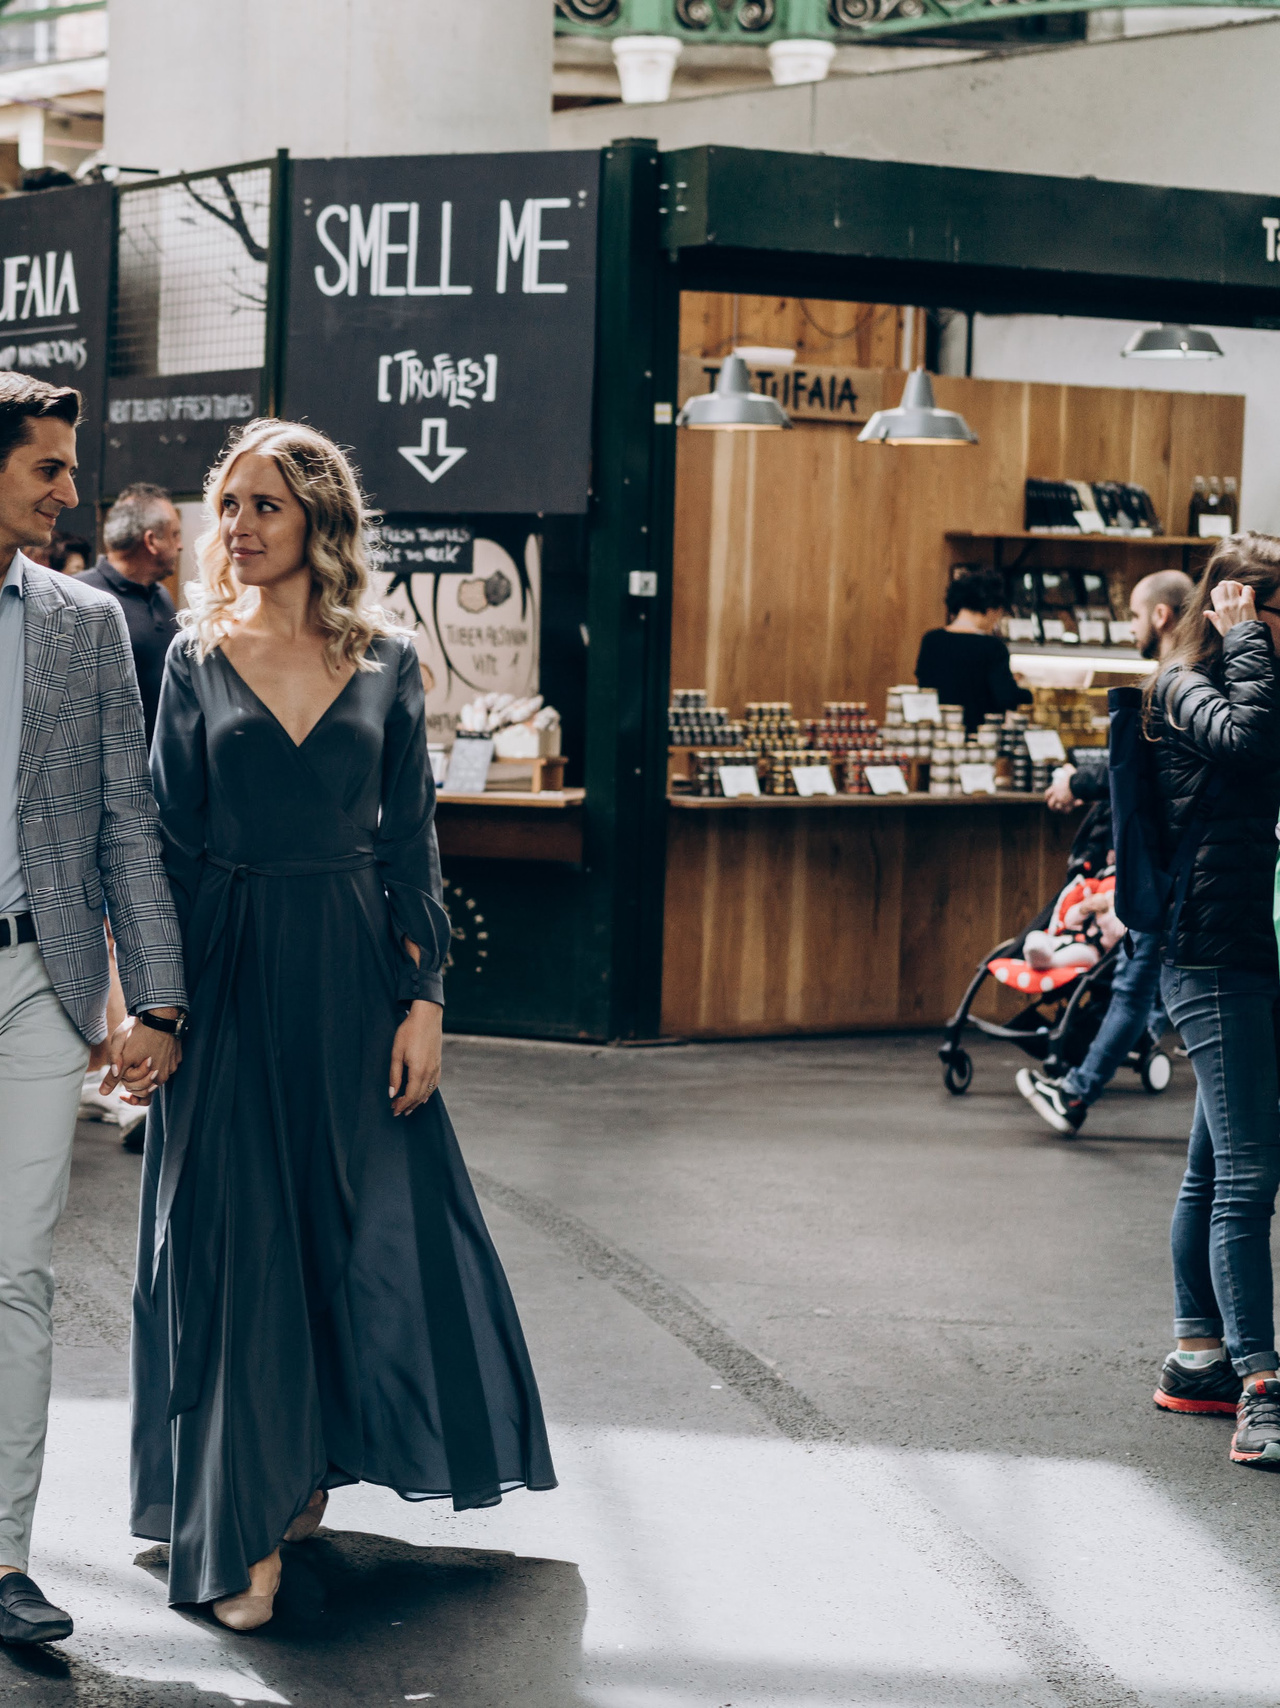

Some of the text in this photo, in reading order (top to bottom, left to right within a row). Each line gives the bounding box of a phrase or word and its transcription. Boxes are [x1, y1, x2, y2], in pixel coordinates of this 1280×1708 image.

[314, 198, 570, 296] SMELL ME
[703, 366, 858, 413] TTUFAIA
